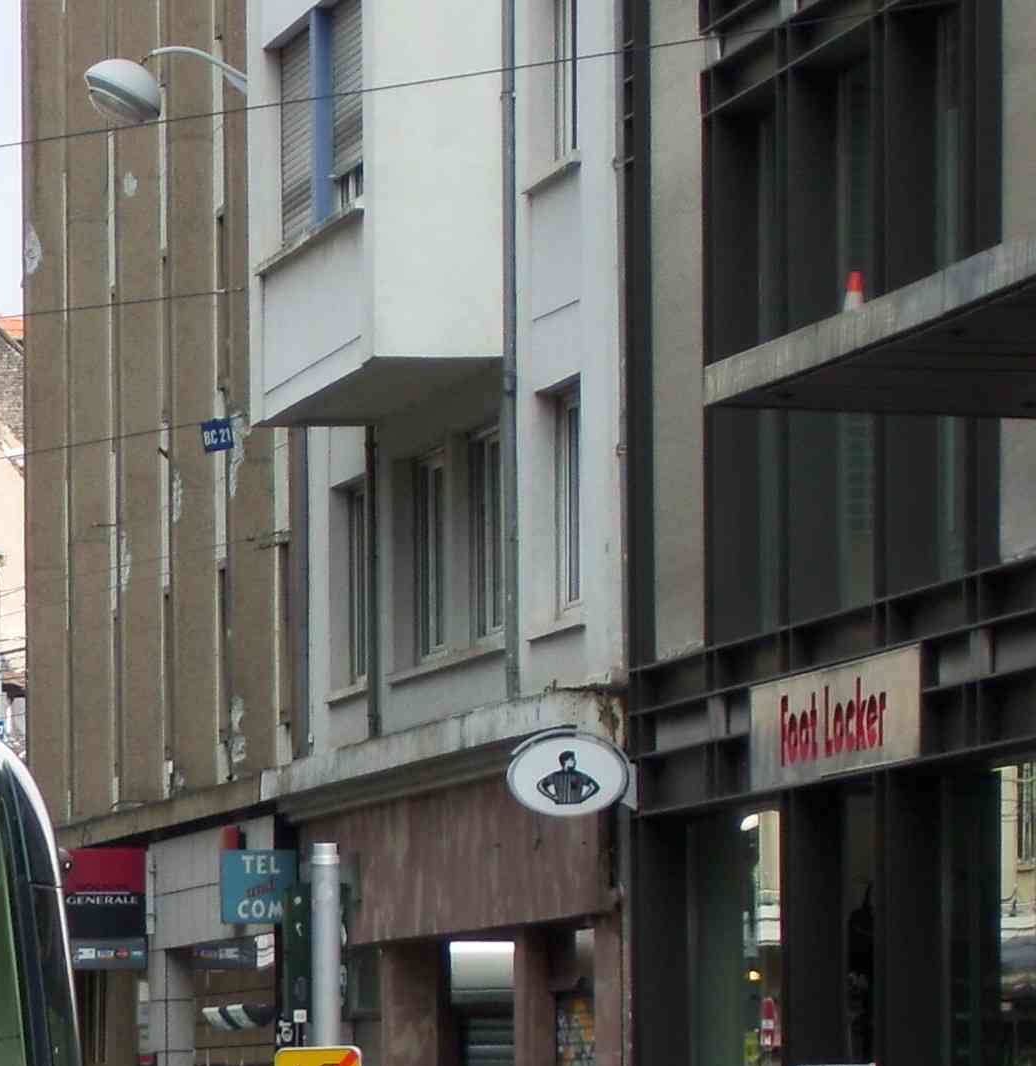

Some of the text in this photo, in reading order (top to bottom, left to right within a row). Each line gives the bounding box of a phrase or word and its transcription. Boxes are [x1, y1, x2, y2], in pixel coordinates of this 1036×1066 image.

[219, 427, 232, 444] 21
[780, 676, 887, 768] Foot Locker
[242, 854, 281, 875] TEL
[237, 899, 285, 920] COM
